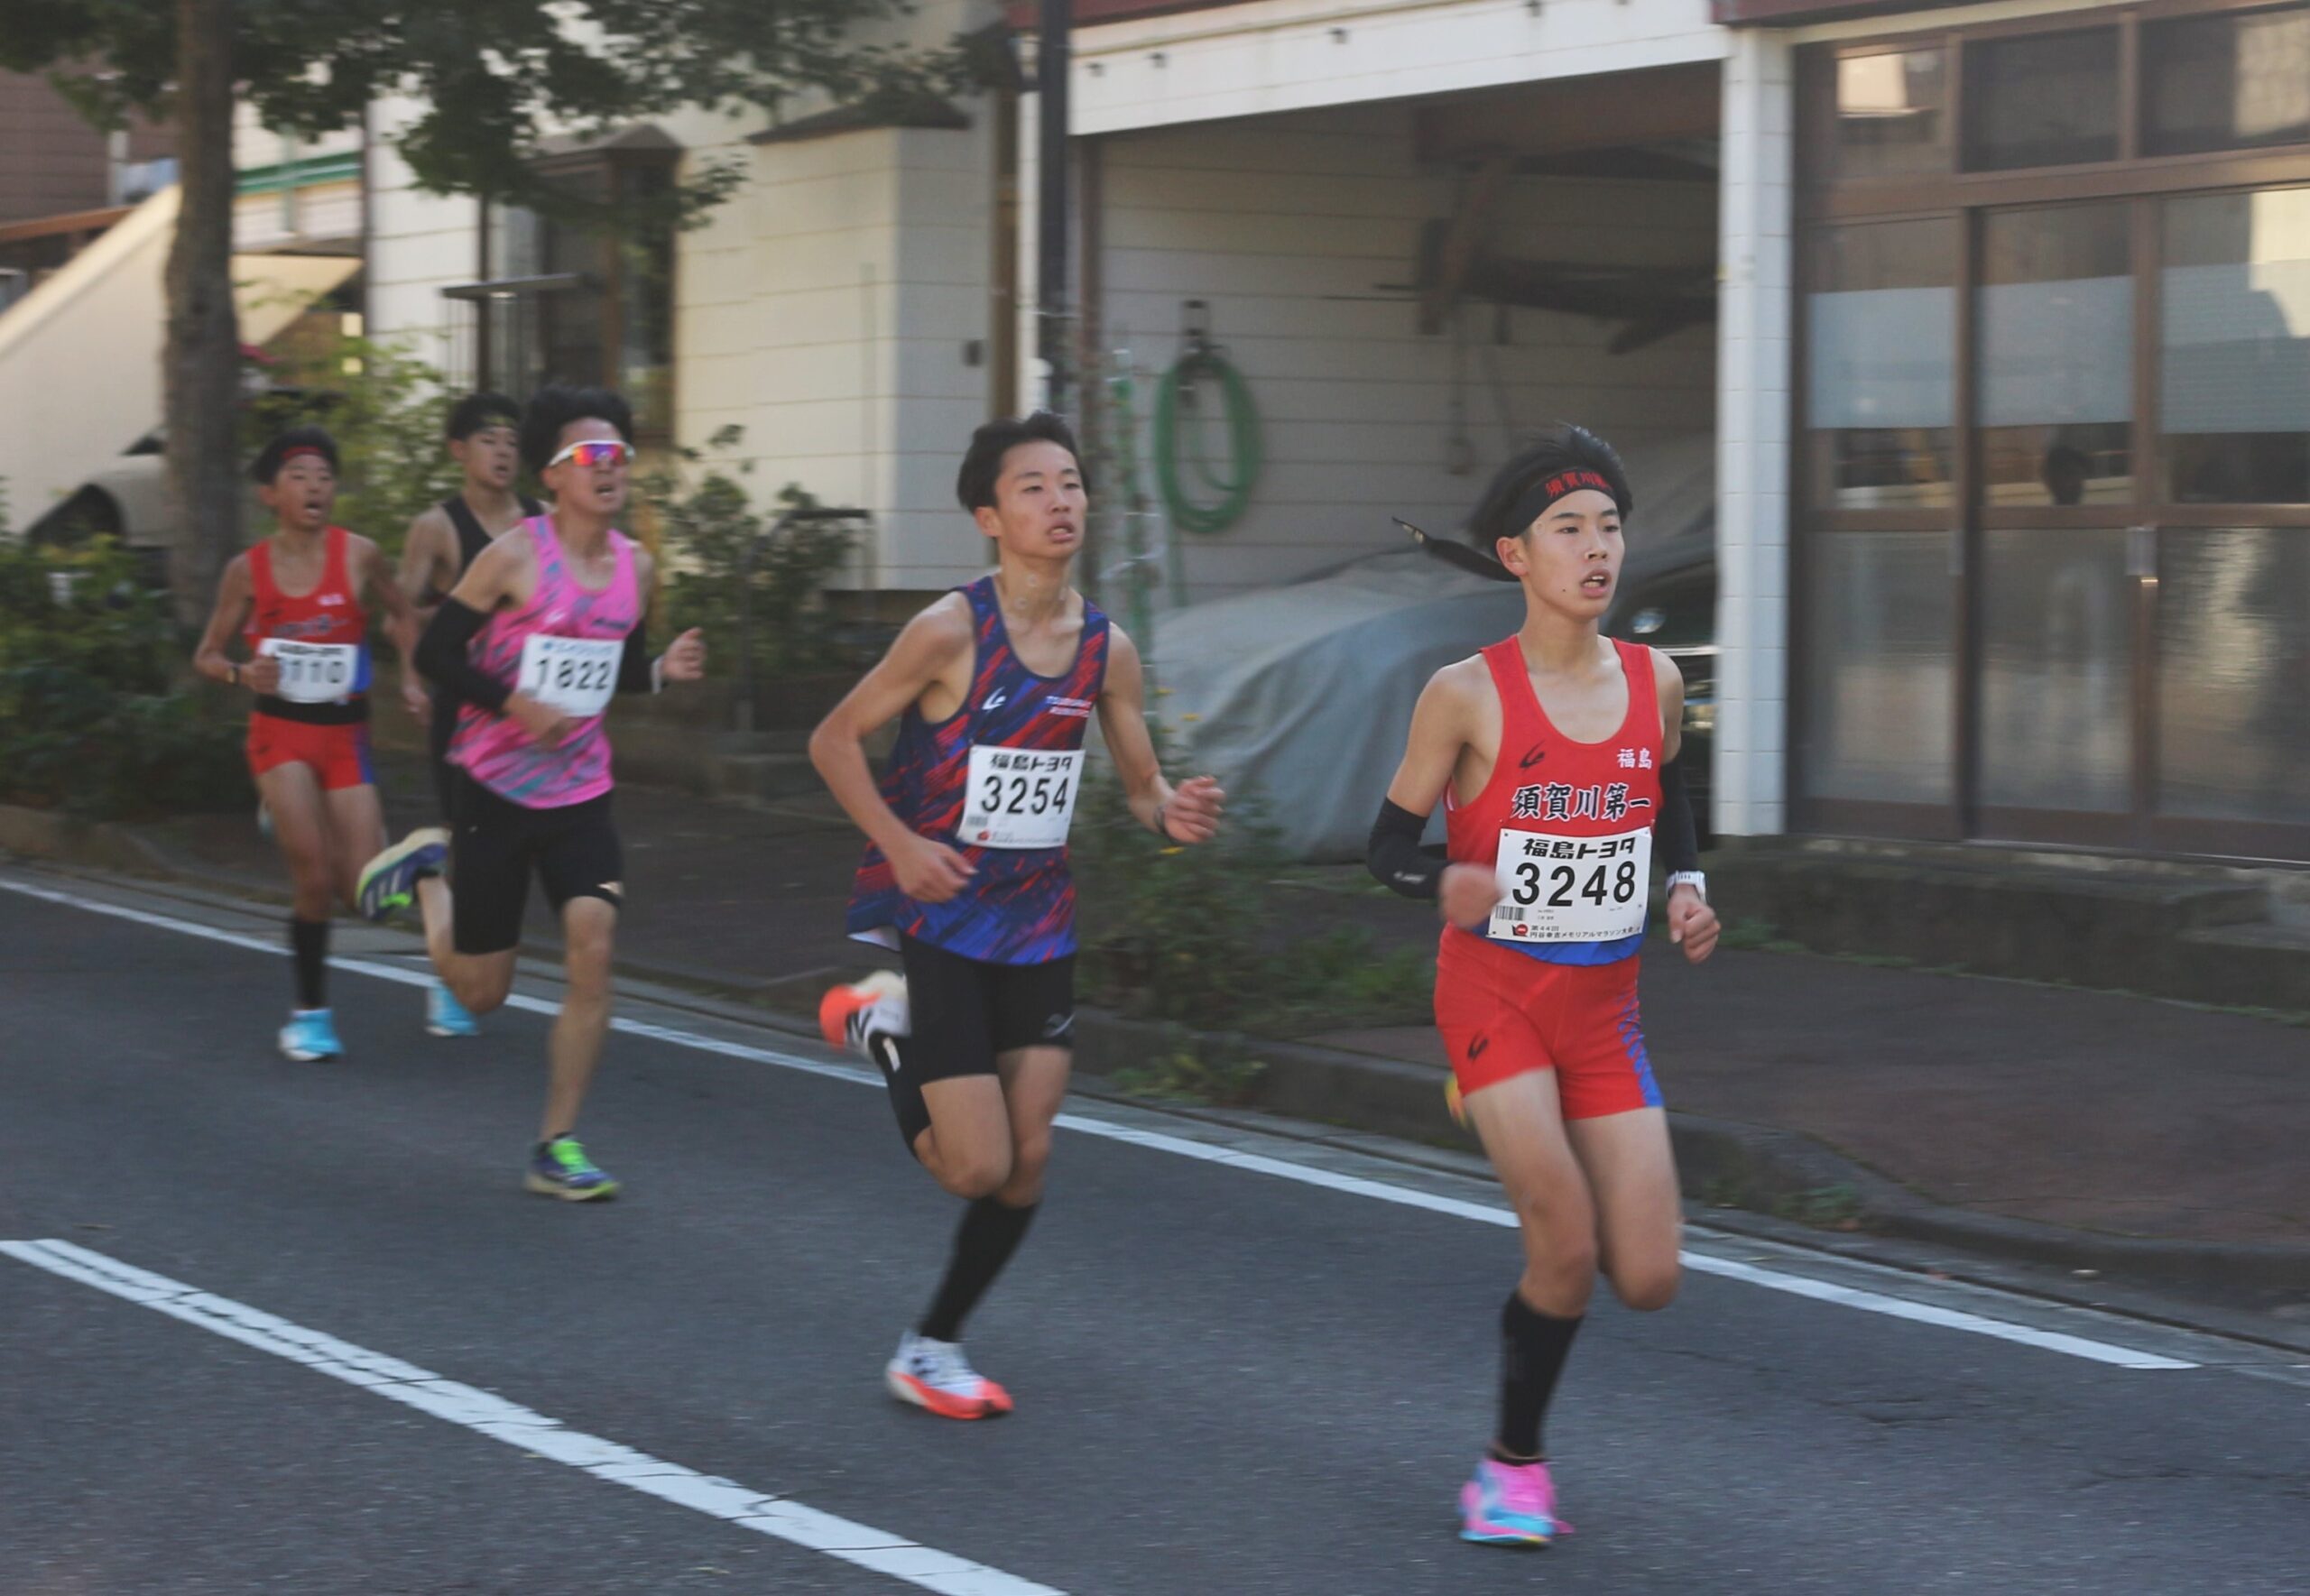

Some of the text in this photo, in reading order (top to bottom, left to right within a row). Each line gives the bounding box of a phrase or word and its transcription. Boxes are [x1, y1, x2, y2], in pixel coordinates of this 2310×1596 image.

[991, 752, 1073, 772] 福島トヨタ
[1617, 748, 1652, 769] 福島
[982, 775, 1068, 815] 3254
[1512, 781, 1651, 821] 須賀川第一
[1522, 836, 1636, 860] 福島トヨタ
[1512, 861, 1636, 907] 3248
